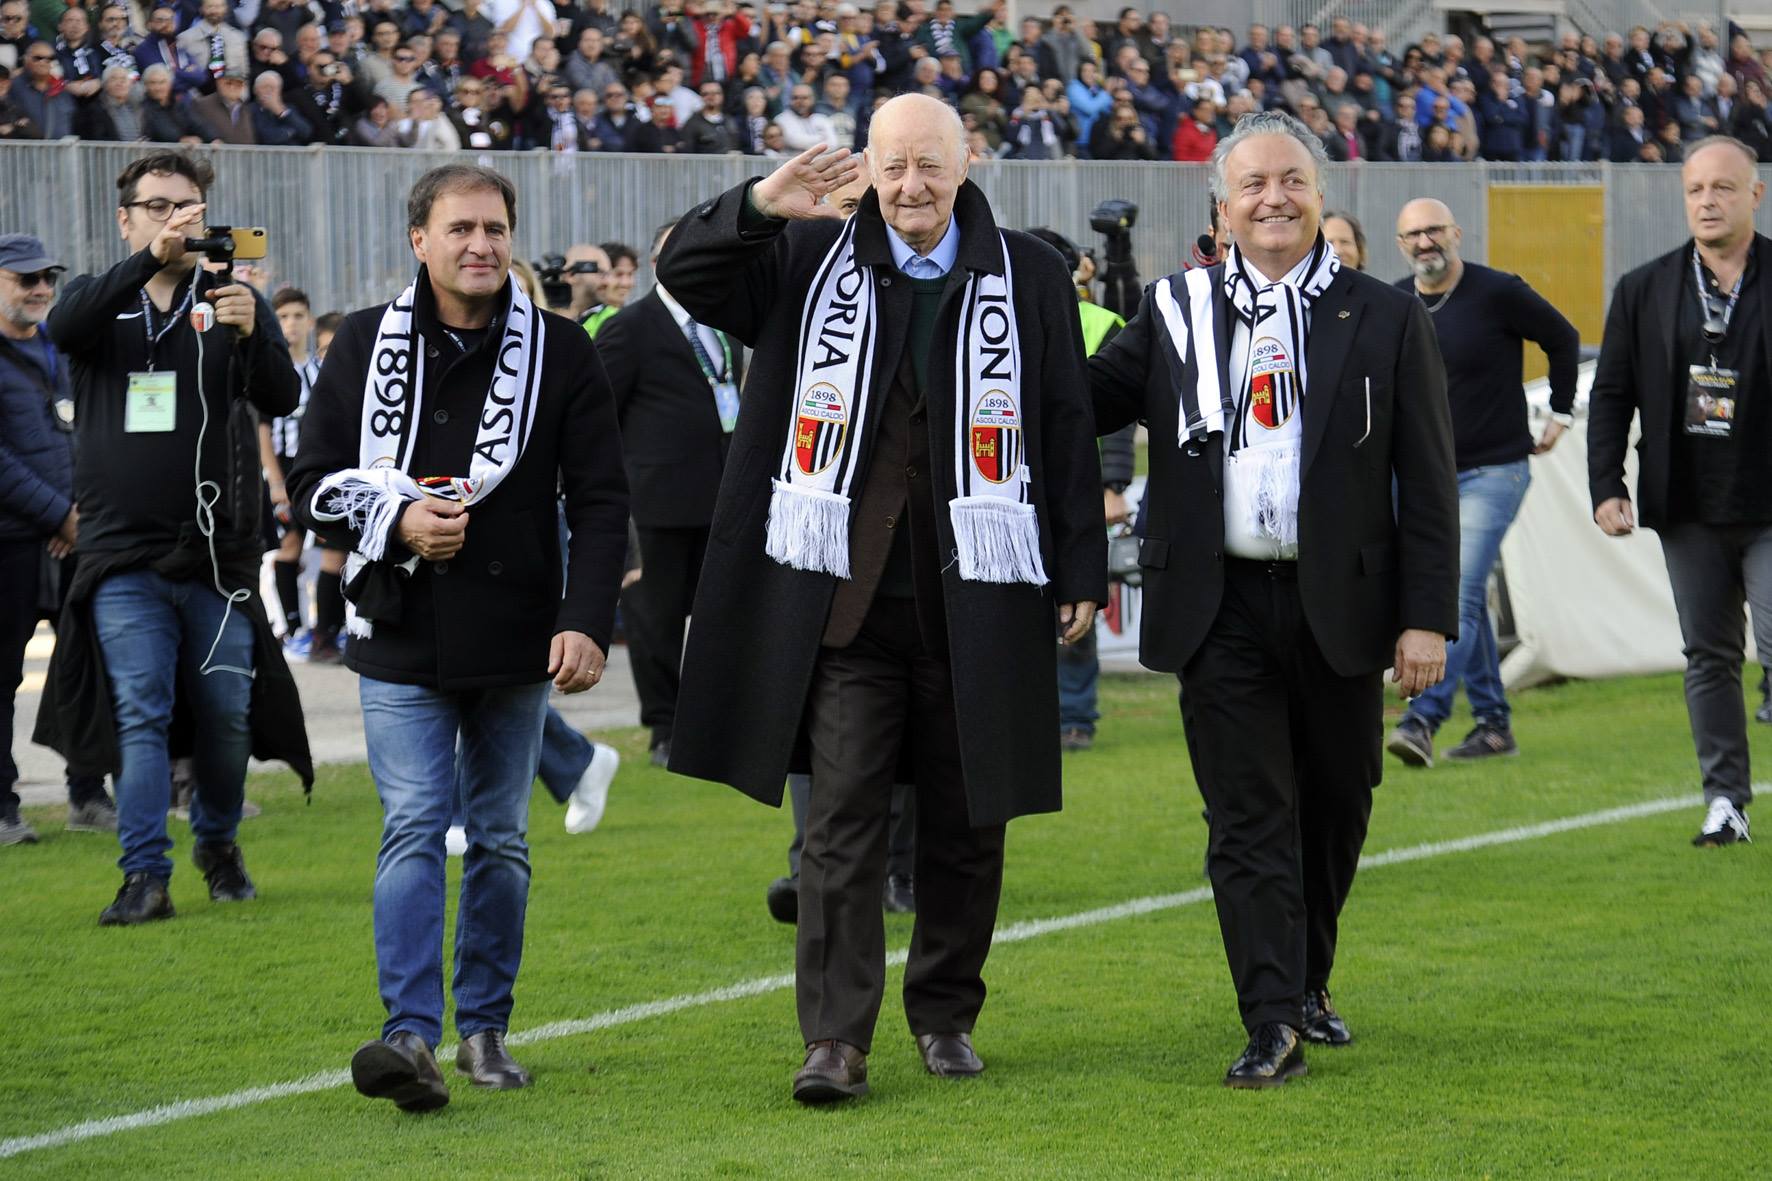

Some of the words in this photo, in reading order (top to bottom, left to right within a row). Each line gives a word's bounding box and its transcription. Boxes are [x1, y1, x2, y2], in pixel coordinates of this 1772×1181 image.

[812, 254, 864, 372] ORIA
[371, 329, 411, 438] 1898
[810, 390, 837, 402] 1898
[984, 398, 1009, 408] 1898
[801, 407, 819, 416] ASCOLI
[820, 410, 844, 420] CALCIO
